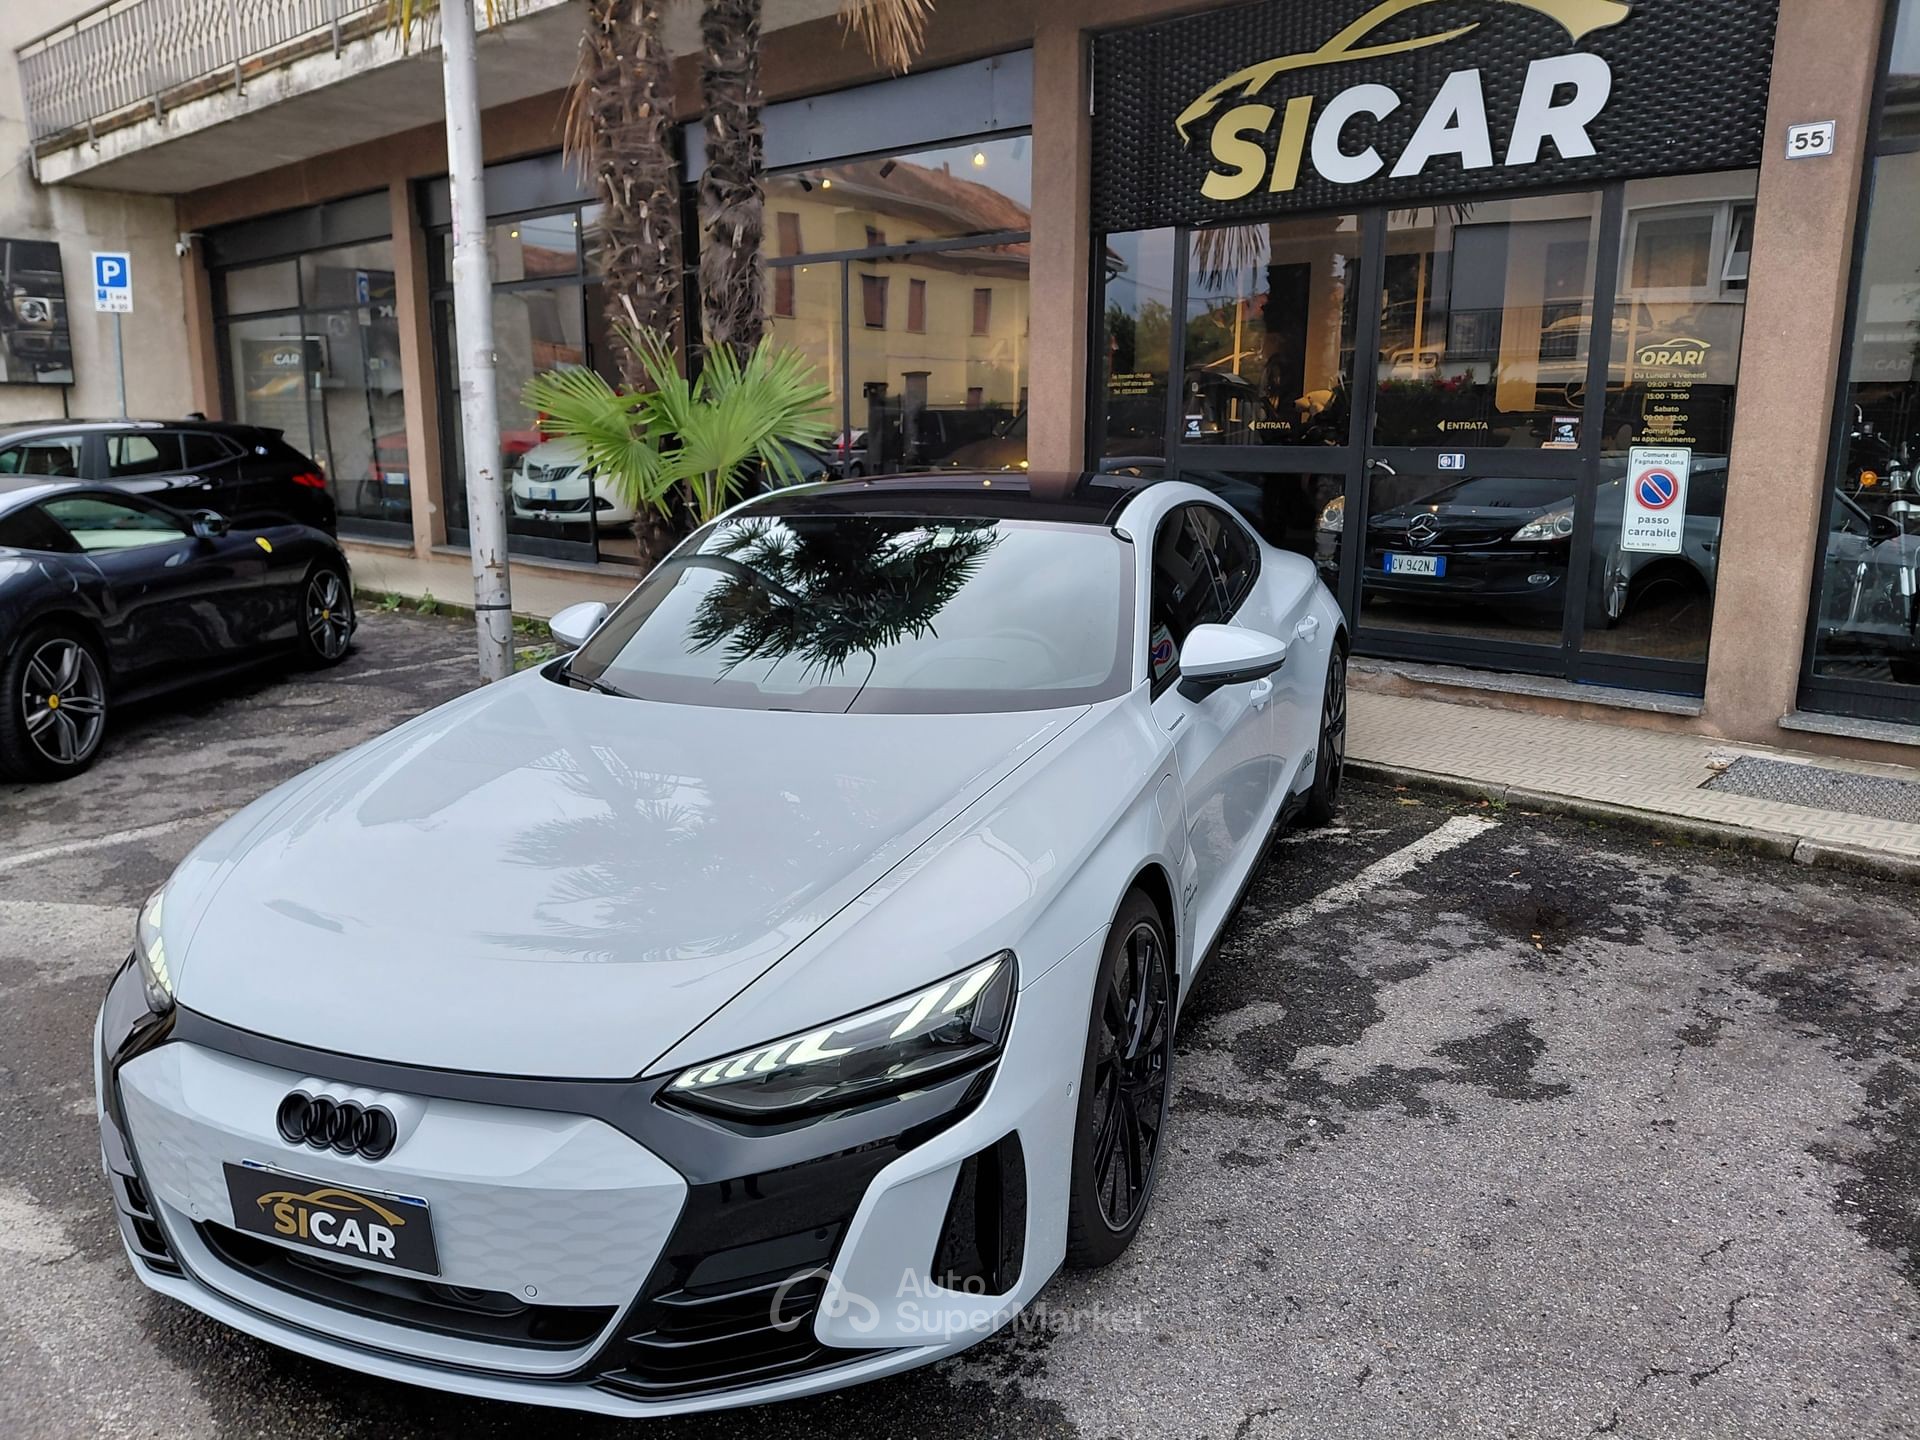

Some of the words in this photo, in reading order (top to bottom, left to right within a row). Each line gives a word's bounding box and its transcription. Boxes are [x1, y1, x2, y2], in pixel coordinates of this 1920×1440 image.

[1199, 51, 1613, 201] SICAR
[1794, 130, 1825, 150] 55
[102, 260, 121, 285] P
[1640, 350, 1705, 366] ORARI
[1256, 421, 1291, 430] ENTRATA
[1446, 421, 1489, 430] ENTRATA
[1643, 427, 1686, 436] Pomeriggio
[1641, 435, 1697, 443] appuntamento
[1634, 458, 1663, 466] Fagnano
[1637, 516, 1670, 525] passo
[1627, 527, 1677, 538] carrabile
[273, 1202, 396, 1260] SICAR
